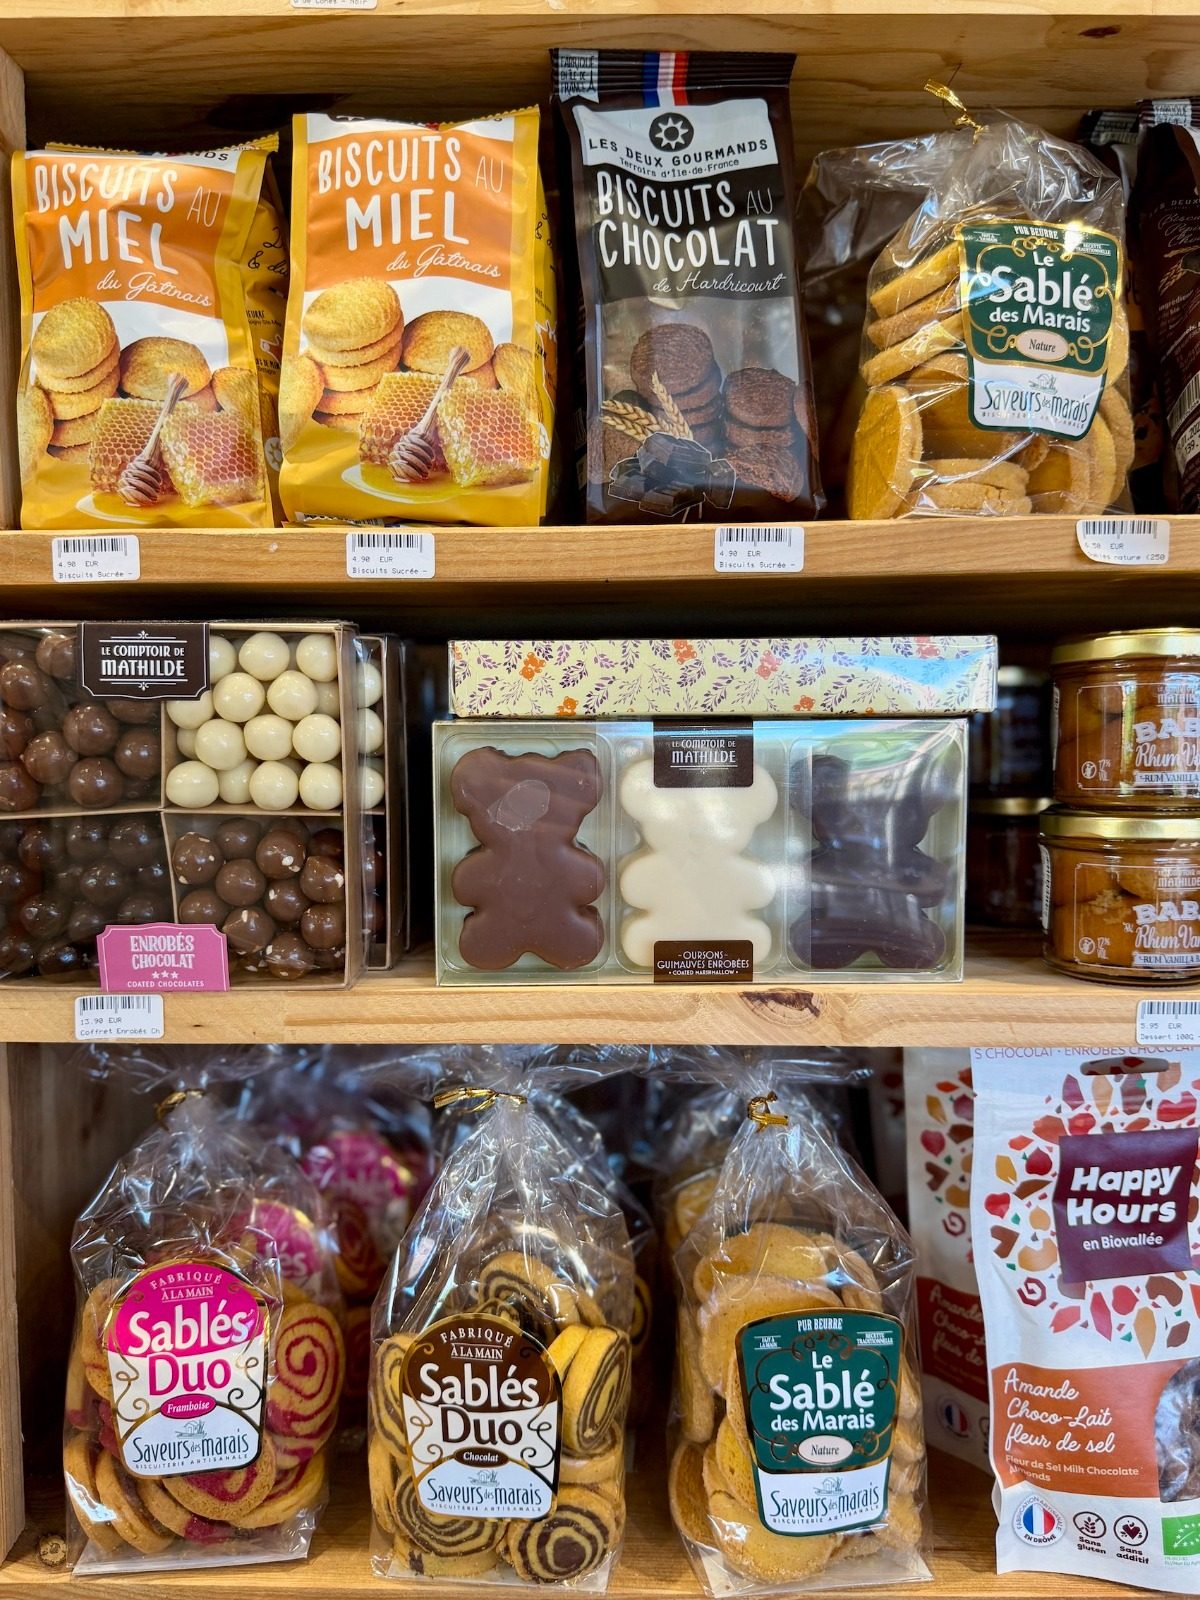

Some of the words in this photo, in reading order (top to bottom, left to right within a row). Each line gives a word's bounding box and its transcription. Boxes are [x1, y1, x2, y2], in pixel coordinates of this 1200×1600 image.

[589, 138, 618, 152] LES
[626, 147, 663, 168] DEUX
[672, 139, 768, 166] GOURMANDS
[319, 135, 461, 194] BISCUITS
[475, 155, 504, 193] AU
[620, 158, 657, 177] Terroirs
[34, 163, 178, 214] BISCUITS
[187, 185, 221, 227] AU
[596, 171, 735, 228] BISCUITS
[746, 187, 773, 216] AU
[346, 188, 469, 252] MIEL
[60, 208, 179, 276] MIEL
[1014, 225, 1030, 236] PUR
[1030, 226, 1059, 240] BEURRE
[599, 219, 779, 272] CHOCOLAT
[387, 250, 410, 272] du
[1033, 251, 1054, 268] Le
[97, 270, 122, 291] du
[652, 275, 671, 293] de
[676, 270, 787, 293] Hardricourt
[988, 265, 1093, 312] Sablé
[989, 308, 1019, 324] des
[1023, 304, 1091, 333] Marais
[1028, 336, 1057, 353] Nature
[980, 380, 1041, 413] Saveurs
[1051, 393, 1091, 423] marais
[1146, 553, 1166, 561] (250
[101, 646, 111, 656] LE
[113, 645, 171, 657] COMPTOIR
[174, 647, 185, 656] DE
[101, 659, 185, 676] MATHILDE
[681, 739, 725, 749] COMPTOIR
[672, 750, 736, 764] MATHILDE
[1136, 743, 1181, 768] Rhum
[1144, 774, 1164, 782] RUM
[1132, 901, 1200, 926] BAB
[130, 932, 194, 952] ENROBÉS
[1135, 925, 1180, 948] Rhum
[132, 953, 195, 970] CHOCOLAT
[657, 960, 705, 969] GUIMAUVES
[708, 958, 749, 968] ENROBÉES
[1143, 955, 1162, 963] RUM
[127, 980, 155, 988] COATED
[158, 980, 204, 988] CHOCOLATES
[80, 1018, 104, 1026] 13.90
[1168, 1022, 1182, 1030] EUR
[80, 1028, 112, 1037] Coffret
[1176, 1033, 1194, 1041] 100G
[985, 1047, 1054, 1060] CHOCOLAT
[1070, 1165, 1182, 1197] Happy
[1066, 1197, 1177, 1227] Hours
[1083, 1240, 1100, 1252] en
[1101, 1233, 1164, 1250] Biovallée
[150, 1270, 223, 1291] FABRIQUÉ
[162, 1286, 169, 1301] À
[171, 1288, 184, 1300] LA
[185, 1286, 214, 1298] MAIN
[128, 1299, 250, 1356] Sablés
[797, 1319, 812, 1333] PUR
[813, 1317, 843, 1330] BEURRE
[440, 1327, 514, 1348] FABRIQUÉ
[451, 1345, 459, 1357] À
[460, 1347, 472, 1358] LA
[473, 1347, 504, 1360] MAIN
[811, 1350, 833, 1369] Le
[148, 1352, 232, 1396] Duo
[420, 1363, 540, 1409] Sablés
[769, 1369, 876, 1411] Sablé
[1004, 1367, 1080, 1401] Amande
[166, 1400, 211, 1414] Framboise
[1007, 1397, 1113, 1429] Choco-Lait
[440, 1404, 523, 1446] Duo
[770, 1413, 799, 1432] des
[802, 1408, 876, 1431] Marais
[132, 1437, 191, 1463] Saveurs
[190, 1440, 202, 1453] des
[202, 1428, 249, 1456] marais
[1004, 1422, 1052, 1452] fleur
[1056, 1431, 1082, 1453] de
[1085, 1431, 1116, 1454] sel
[463, 1451, 500, 1463] Chocolat
[810, 1444, 840, 1456] Nature
[135, 1461, 185, 1469] BISCUITERIE
[190, 1454, 249, 1466] ARTISANALE
[1006, 1454, 1029, 1467] Fleur
[1031, 1459, 1044, 1470] de
[1045, 1462, 1061, 1472] Sel
[1087, 1465, 1140, 1476] Chocolate
[1009, 1465, 1051, 1482] Almonds
[427, 1478, 484, 1505] Saveurs
[494, 1482, 542, 1506] marais
[769, 1490, 829, 1518] Saveurs
[838, 1482, 880, 1514] marais
[1024, 1533, 1033, 1542] EN
[1079, 1536, 1102, 1547] Sans
[1077, 1543, 1107, 1554] gluten
[1116, 1552, 1150, 1564] additif
[1120, 1546, 1143, 1556] Sans
